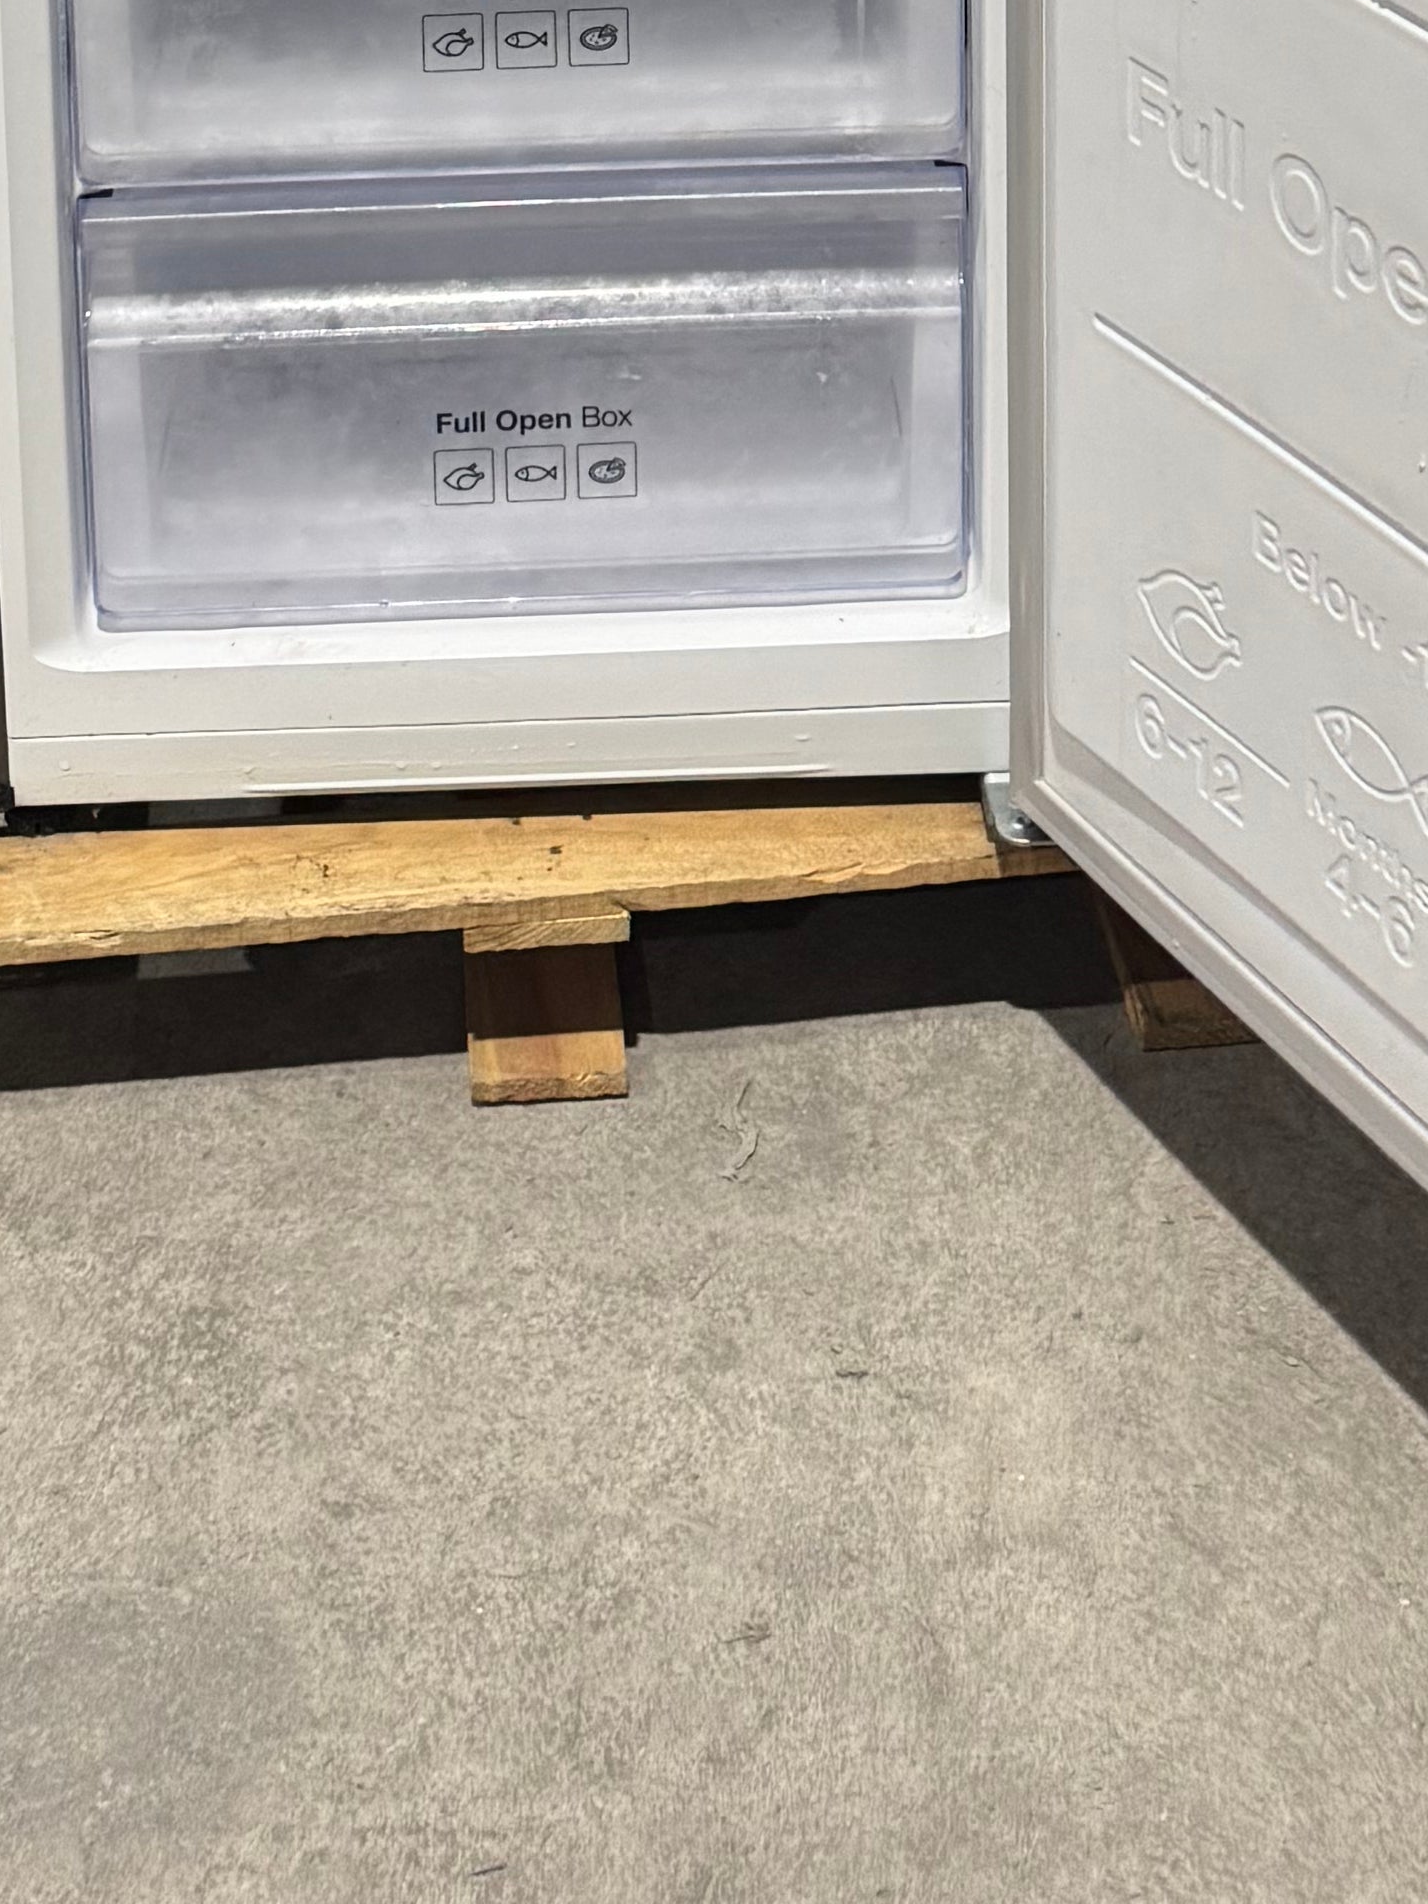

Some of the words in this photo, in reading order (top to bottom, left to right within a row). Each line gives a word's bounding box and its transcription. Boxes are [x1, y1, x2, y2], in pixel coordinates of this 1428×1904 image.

[1125, 55, 1247, 212] Full
[436, 410, 486, 434] Full
[495, 409, 572, 436] Open
[581, 405, 633, 428] Box
[1252, 509, 1388, 652] Below
